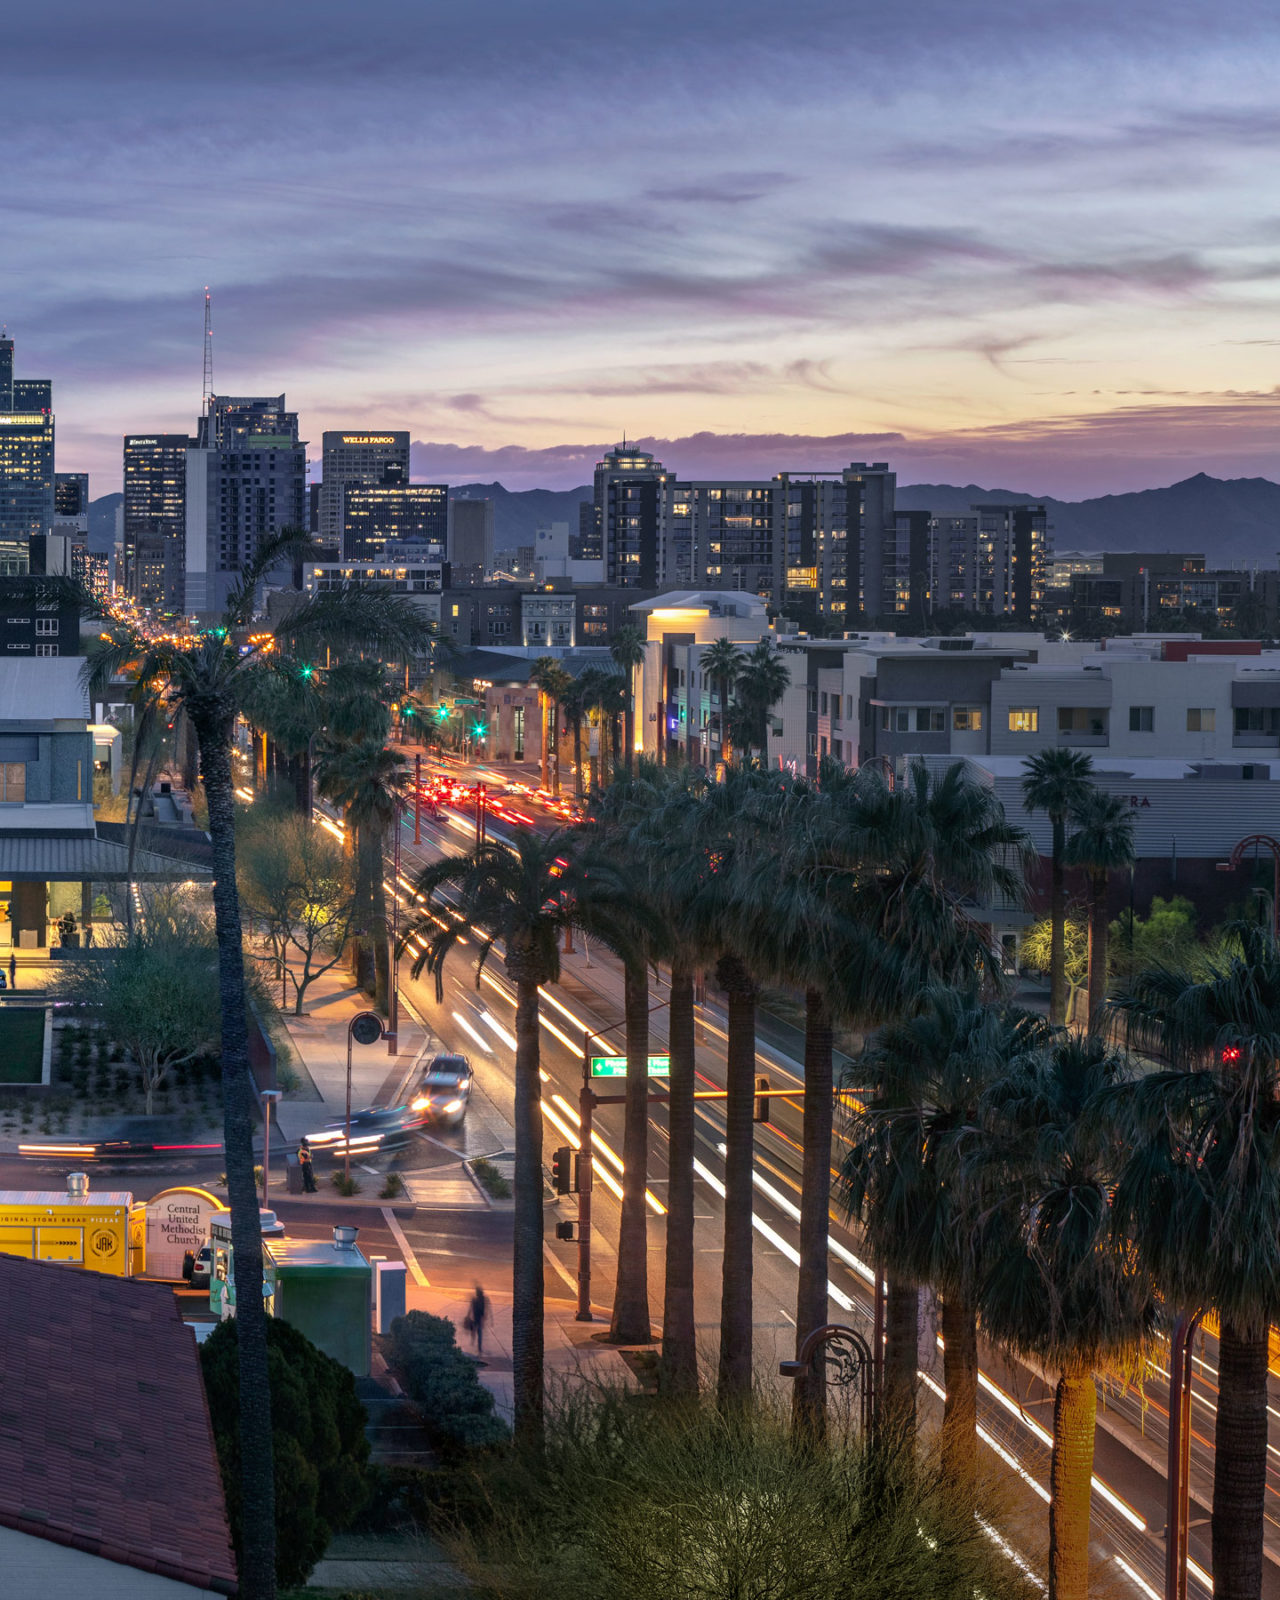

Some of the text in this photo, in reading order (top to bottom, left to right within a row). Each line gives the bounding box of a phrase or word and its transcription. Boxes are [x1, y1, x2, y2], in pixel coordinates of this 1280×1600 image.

[343, 436, 395, 444] WELLS FARGO
[167, 1204, 200, 1214] Central
[168, 1214, 199, 1224] United
[161, 1224, 206, 1235] Methodist
[96, 1237, 113, 1251] JAK
[166, 1234, 200, 1245] Church
